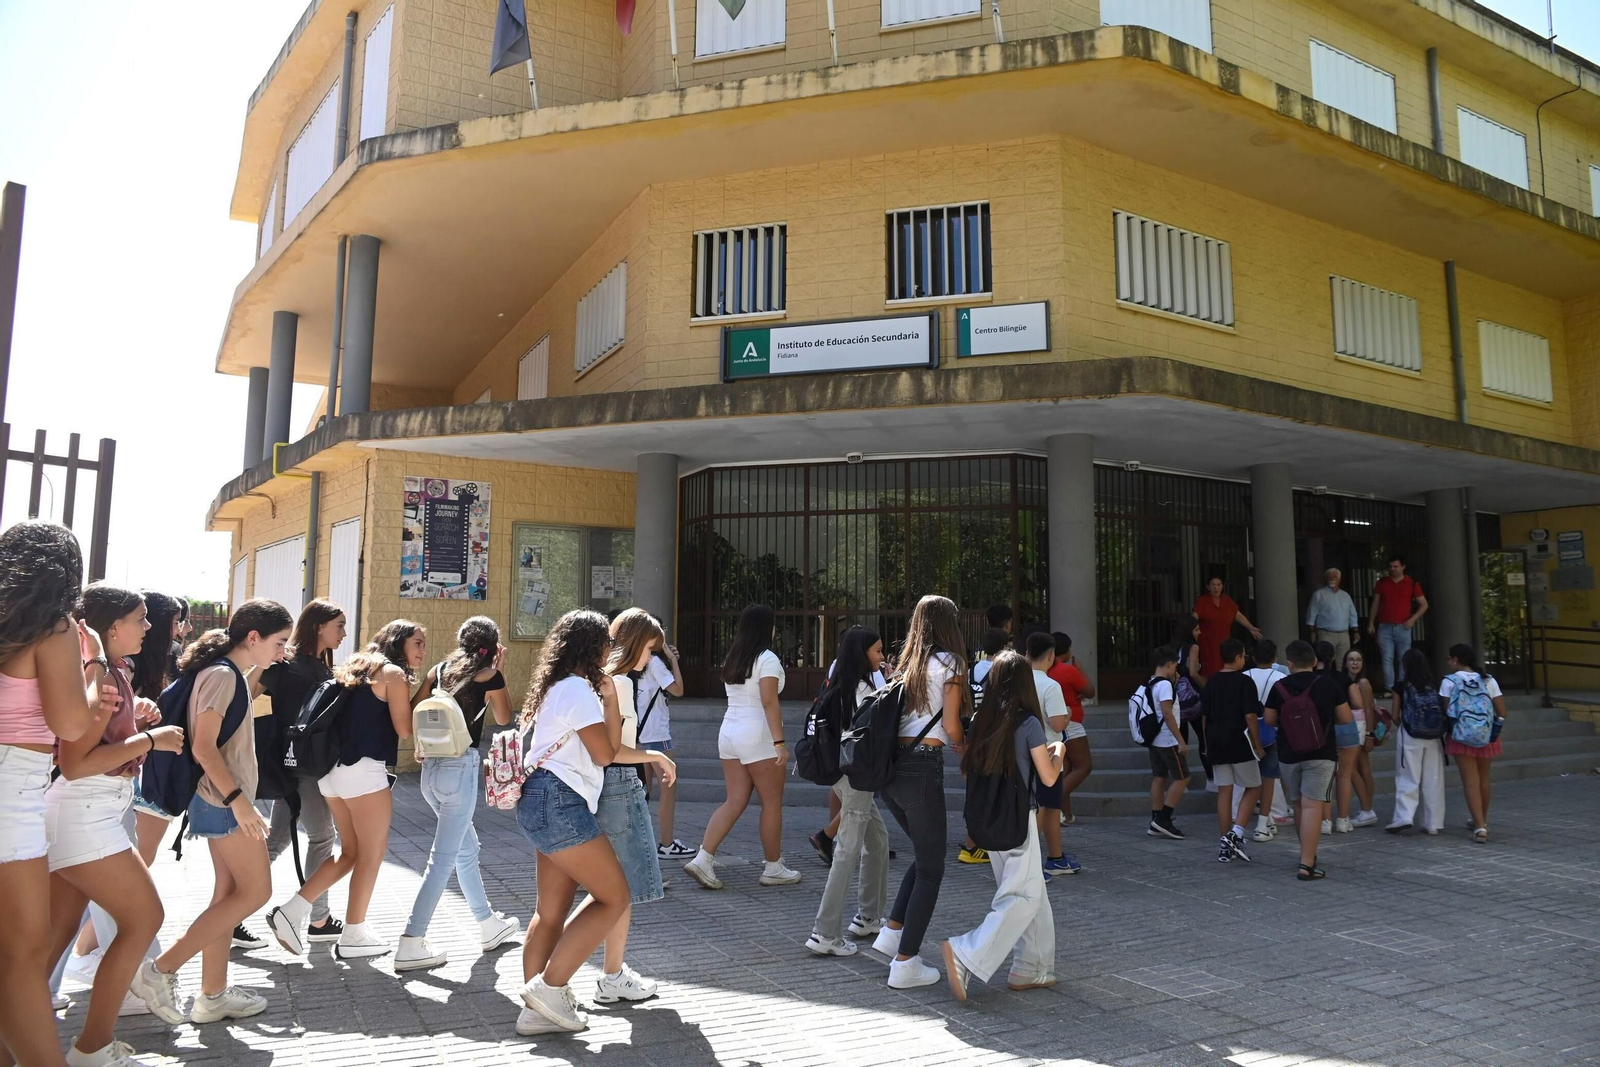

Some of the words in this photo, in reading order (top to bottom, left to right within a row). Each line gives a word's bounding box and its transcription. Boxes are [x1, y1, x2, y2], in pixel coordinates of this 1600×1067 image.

[974, 326, 998, 335] Centro
[999, 324, 1027, 335] Bilingüe
[777, 339, 813, 350] Instituto
[814, 339, 825, 347] de
[826, 333, 869, 346] Educación
[871, 331, 920, 343] Secundaria
[434, 522, 460, 532] SCRATCH
[435, 535, 457, 545] SCREEN
